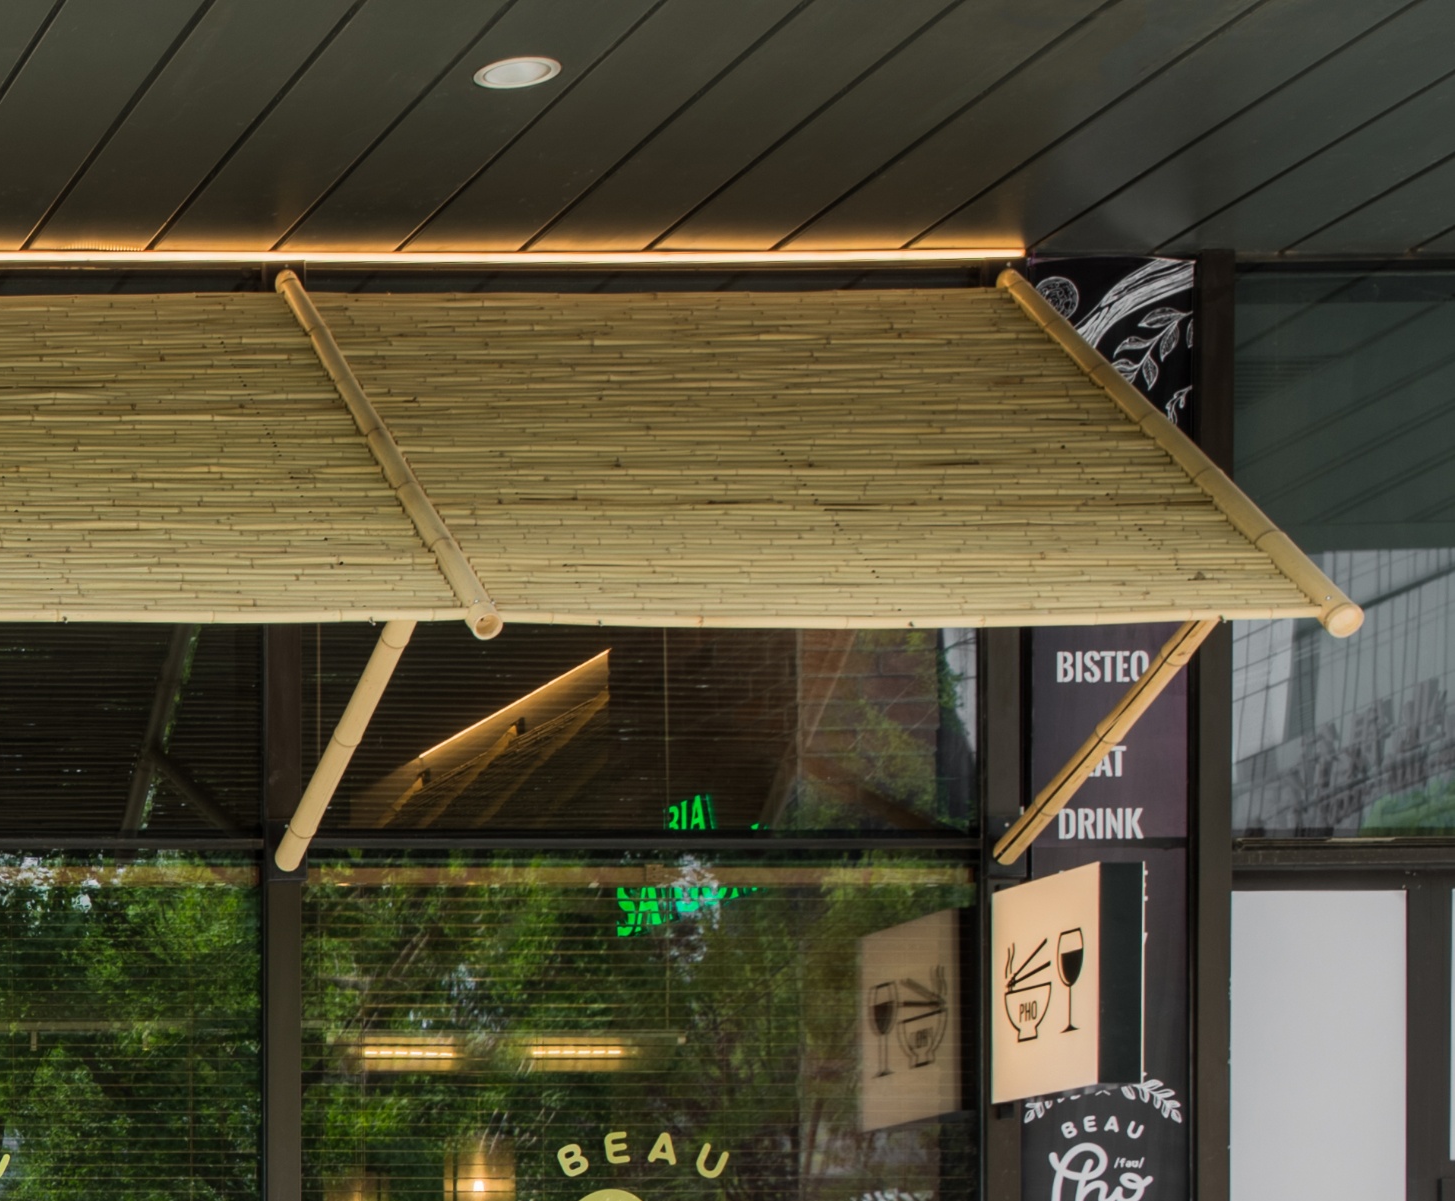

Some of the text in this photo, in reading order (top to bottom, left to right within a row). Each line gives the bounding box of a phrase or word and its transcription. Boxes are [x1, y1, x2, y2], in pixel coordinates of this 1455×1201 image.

[1089, 745, 1127, 777] AT
[1058, 807, 1144, 840] DRINK
[1019, 999, 1038, 1024] PHO
[1061, 1115, 1144, 1139] BEAU
[557, 1131, 730, 1179] BEAU
